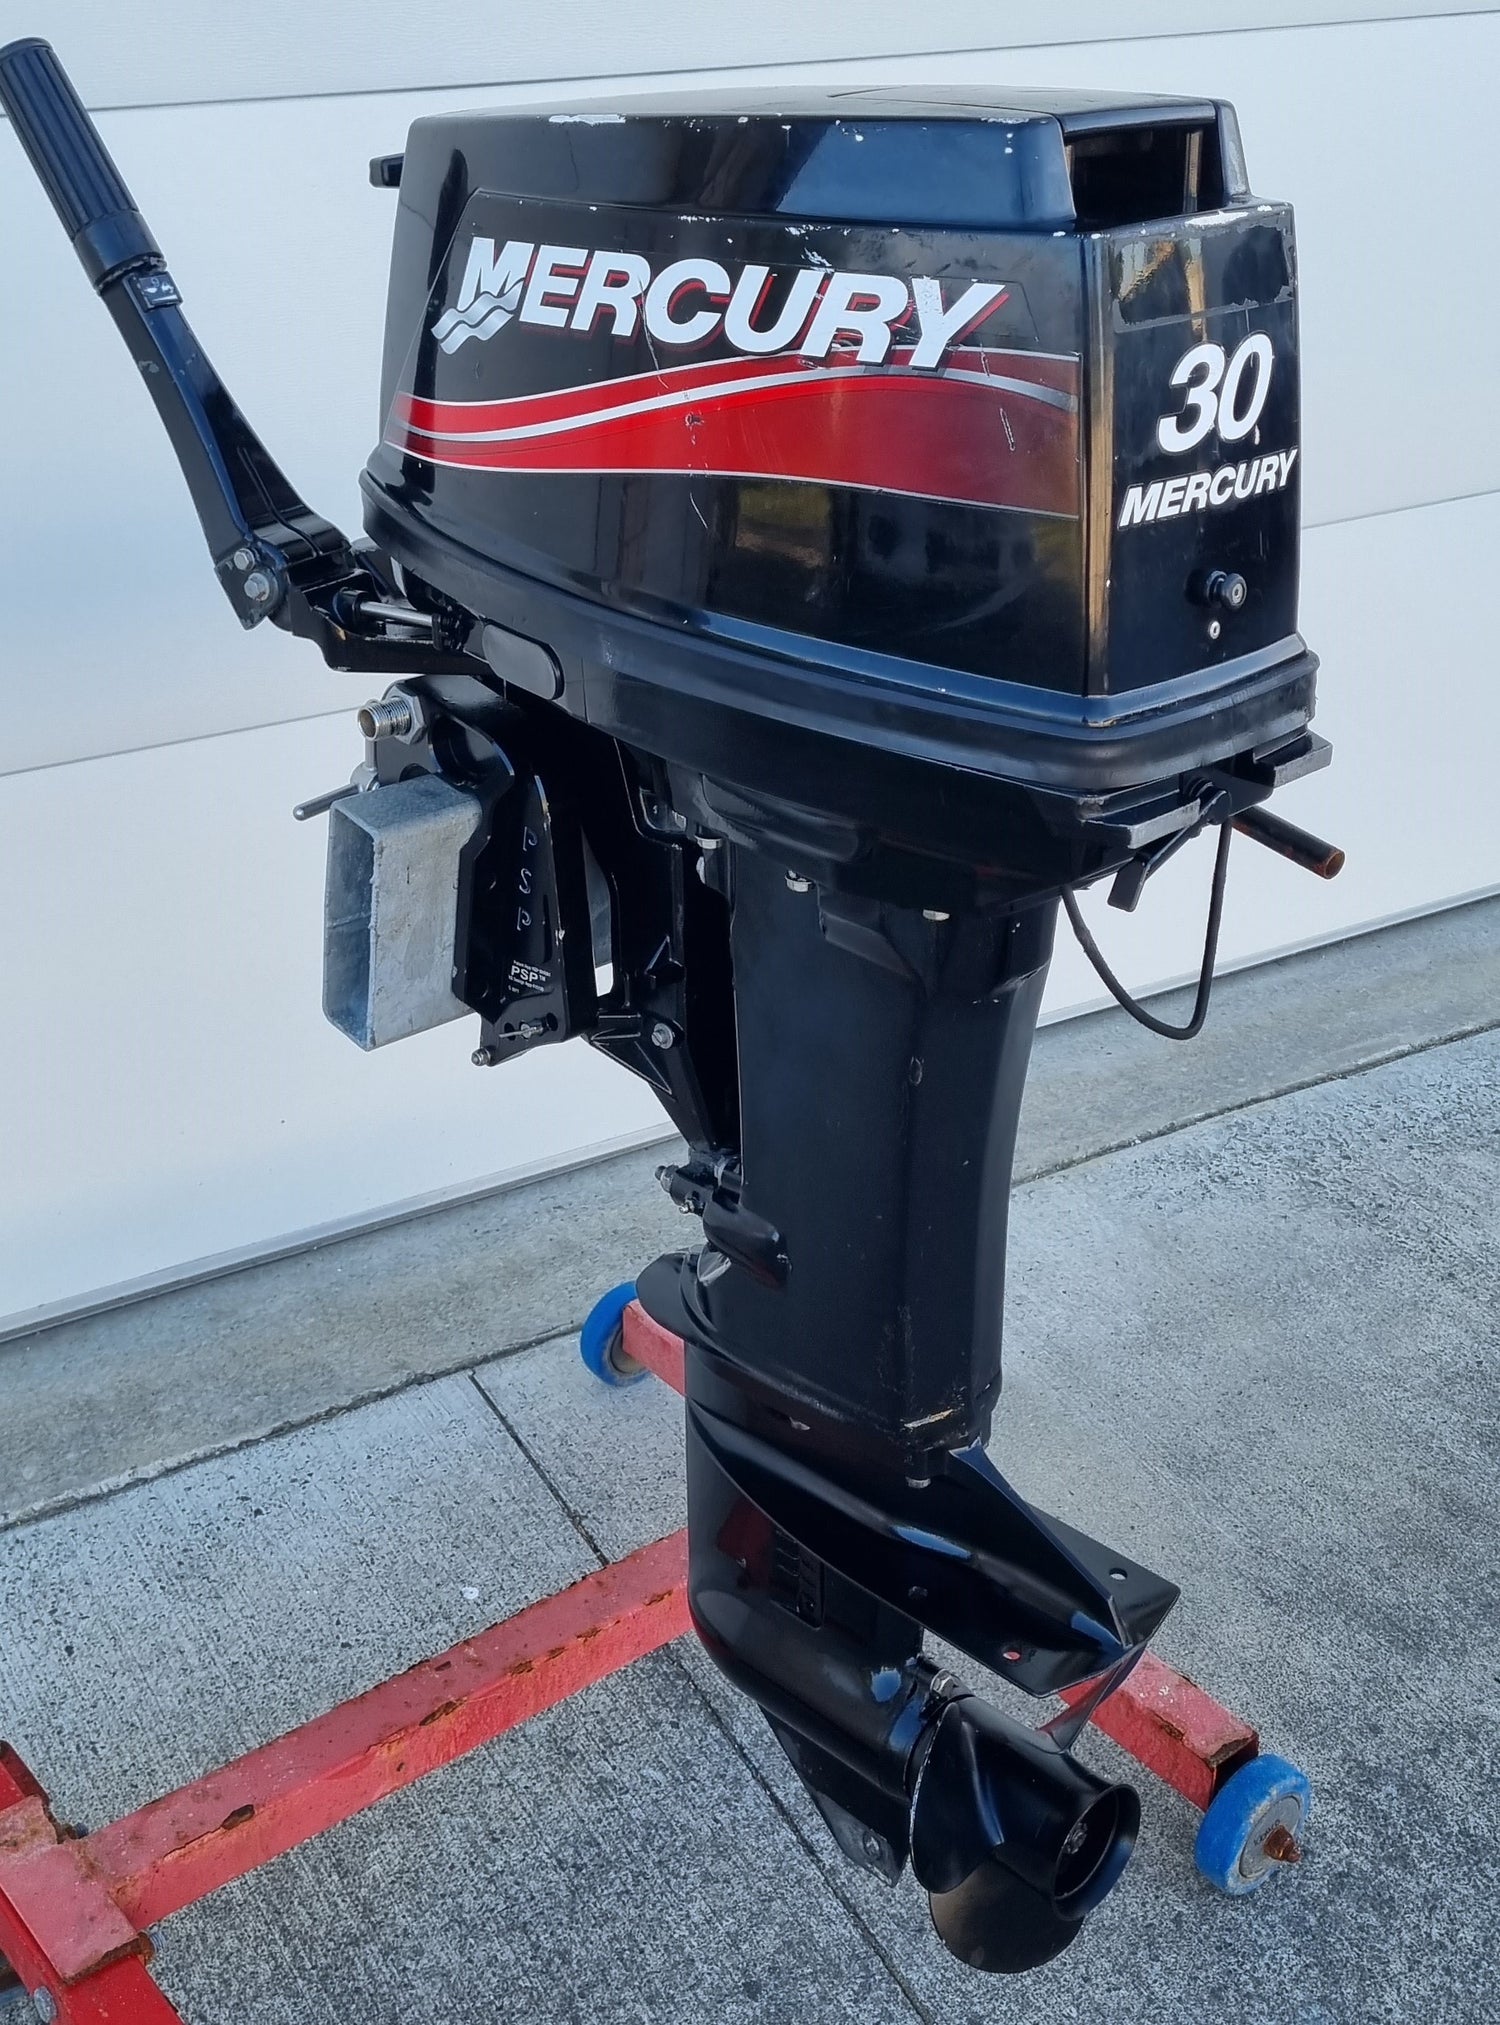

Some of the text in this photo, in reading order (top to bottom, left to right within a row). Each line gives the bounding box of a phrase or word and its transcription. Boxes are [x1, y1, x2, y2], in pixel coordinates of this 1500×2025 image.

[432, 237, 1006, 368] MERCURY
[1157, 333, 1274, 454] 30
[1118, 447, 1299, 530] MERCURY
